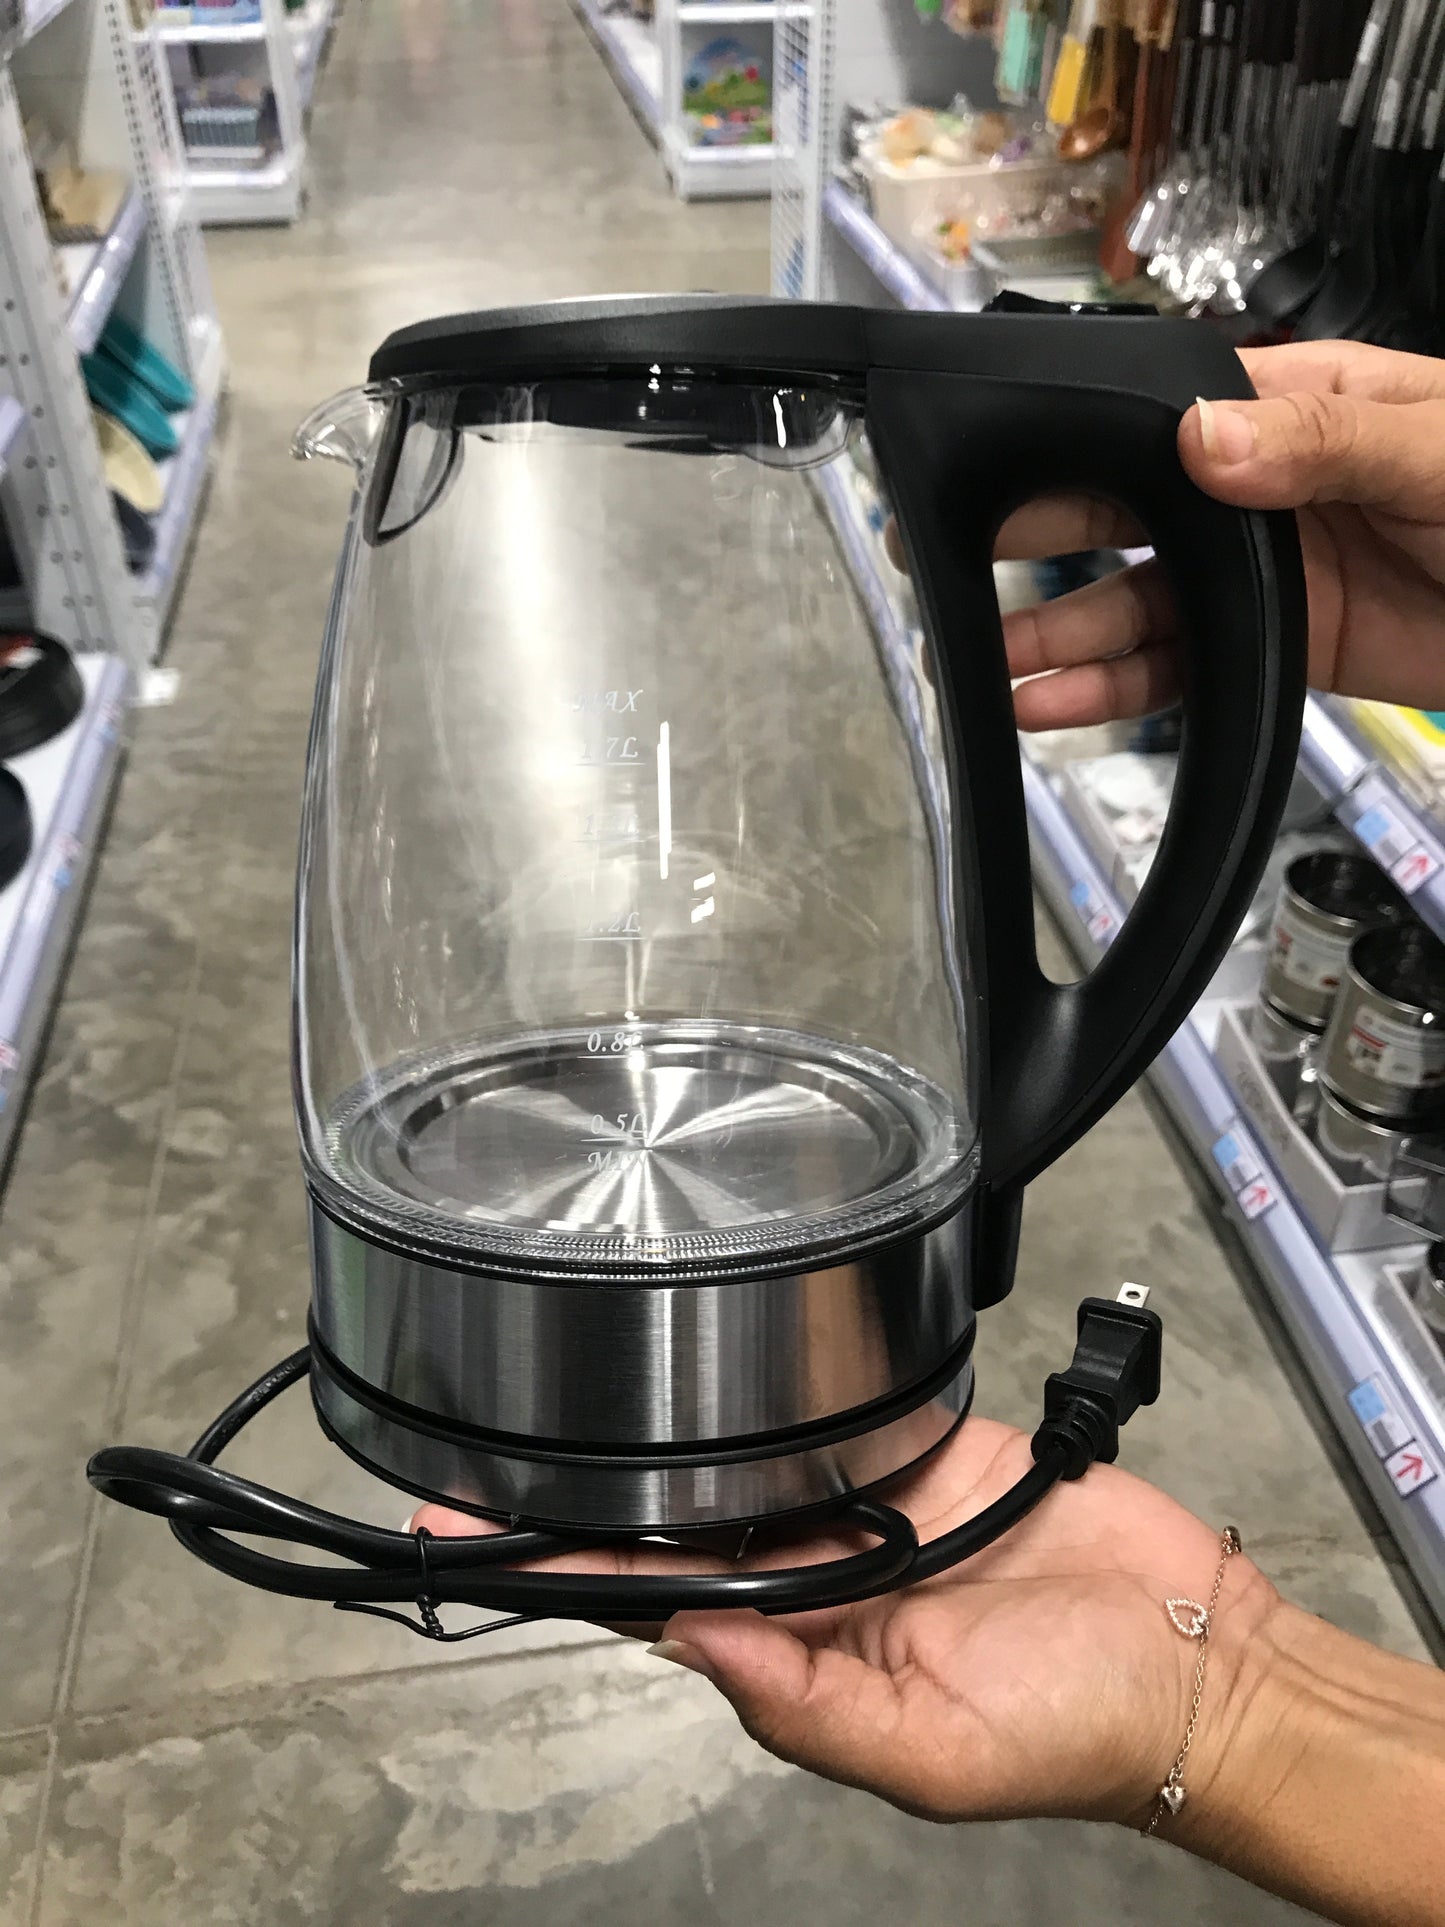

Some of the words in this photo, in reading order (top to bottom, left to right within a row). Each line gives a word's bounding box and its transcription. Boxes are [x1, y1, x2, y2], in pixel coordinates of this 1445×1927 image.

[581, 736, 639, 759] 17L
[584, 911, 642, 933] 1.2L
[587, 1031, 644, 1052] 0.8L
[590, 1113, 647, 1135] 05L
